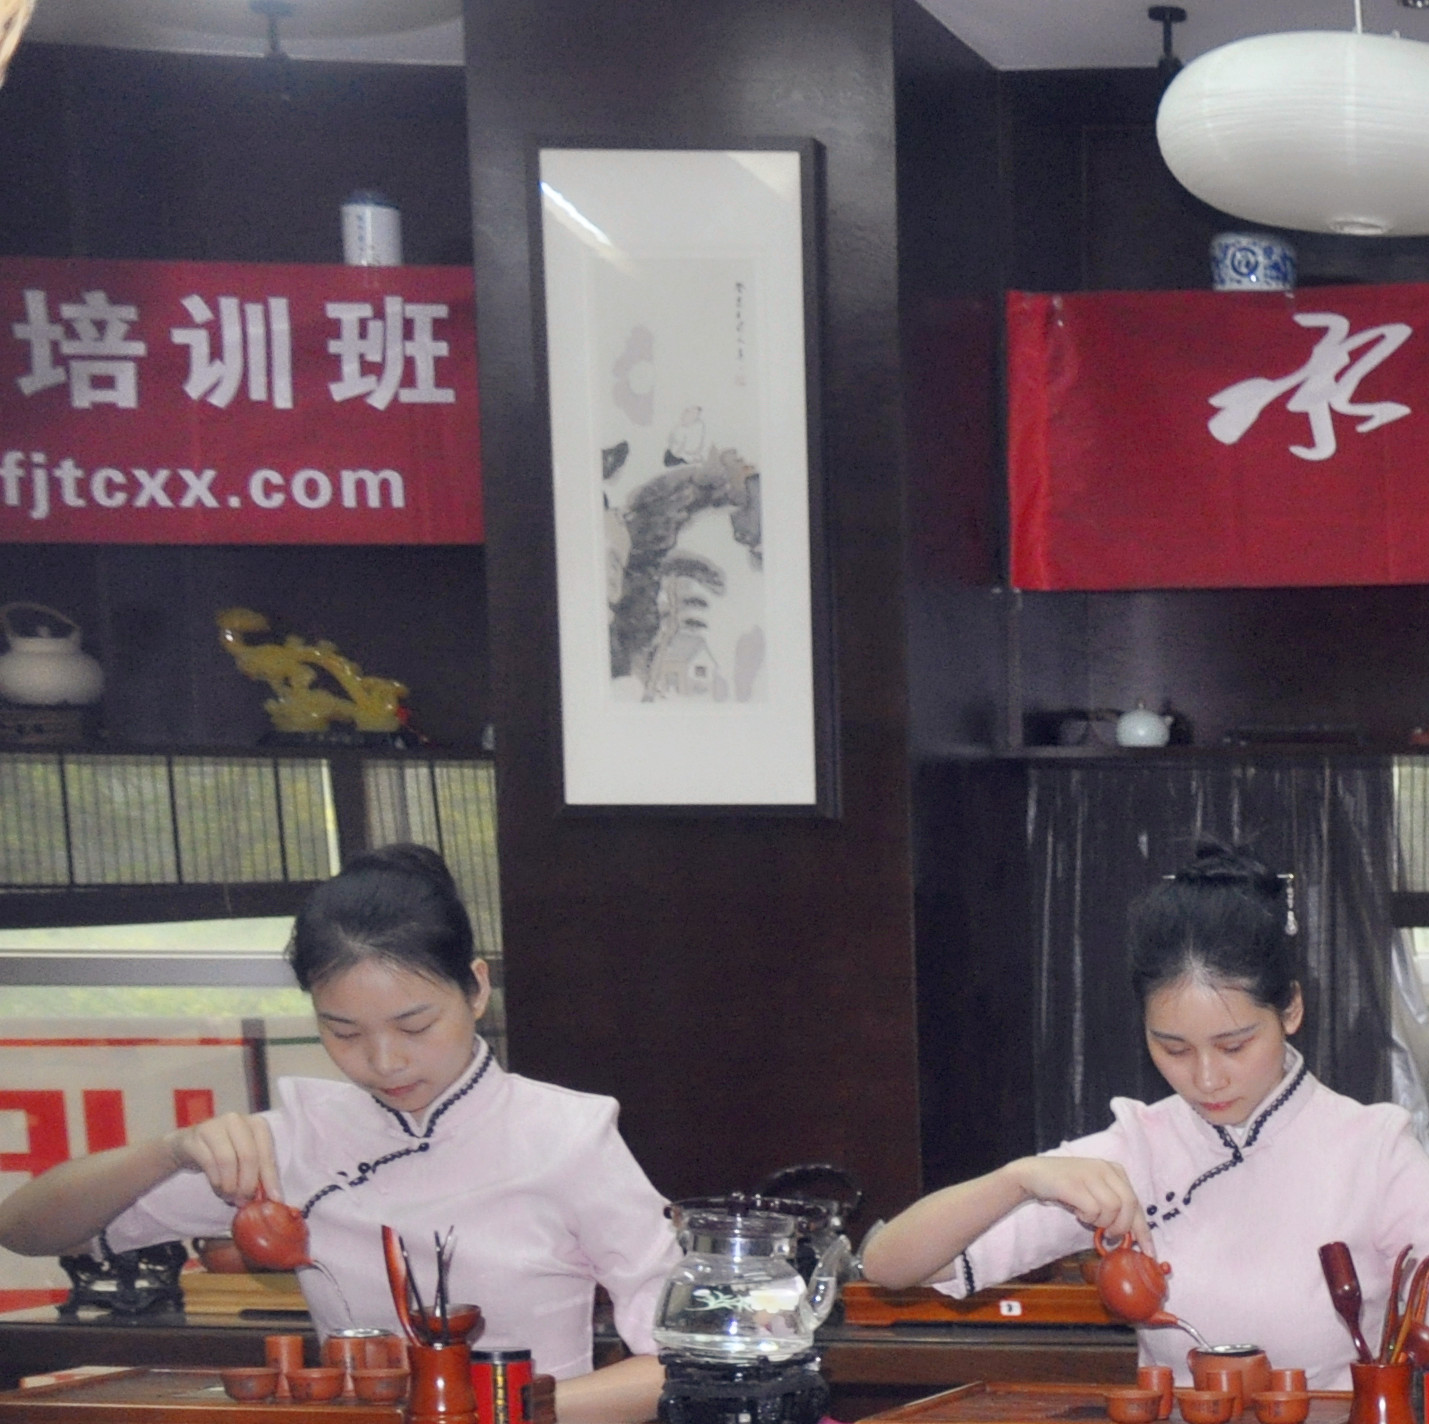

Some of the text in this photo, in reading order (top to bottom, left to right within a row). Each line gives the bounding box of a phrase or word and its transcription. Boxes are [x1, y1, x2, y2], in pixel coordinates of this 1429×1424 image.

[12, 290, 456, 412] 培训班
[0, 450, 405, 520] fjtcxx.com
